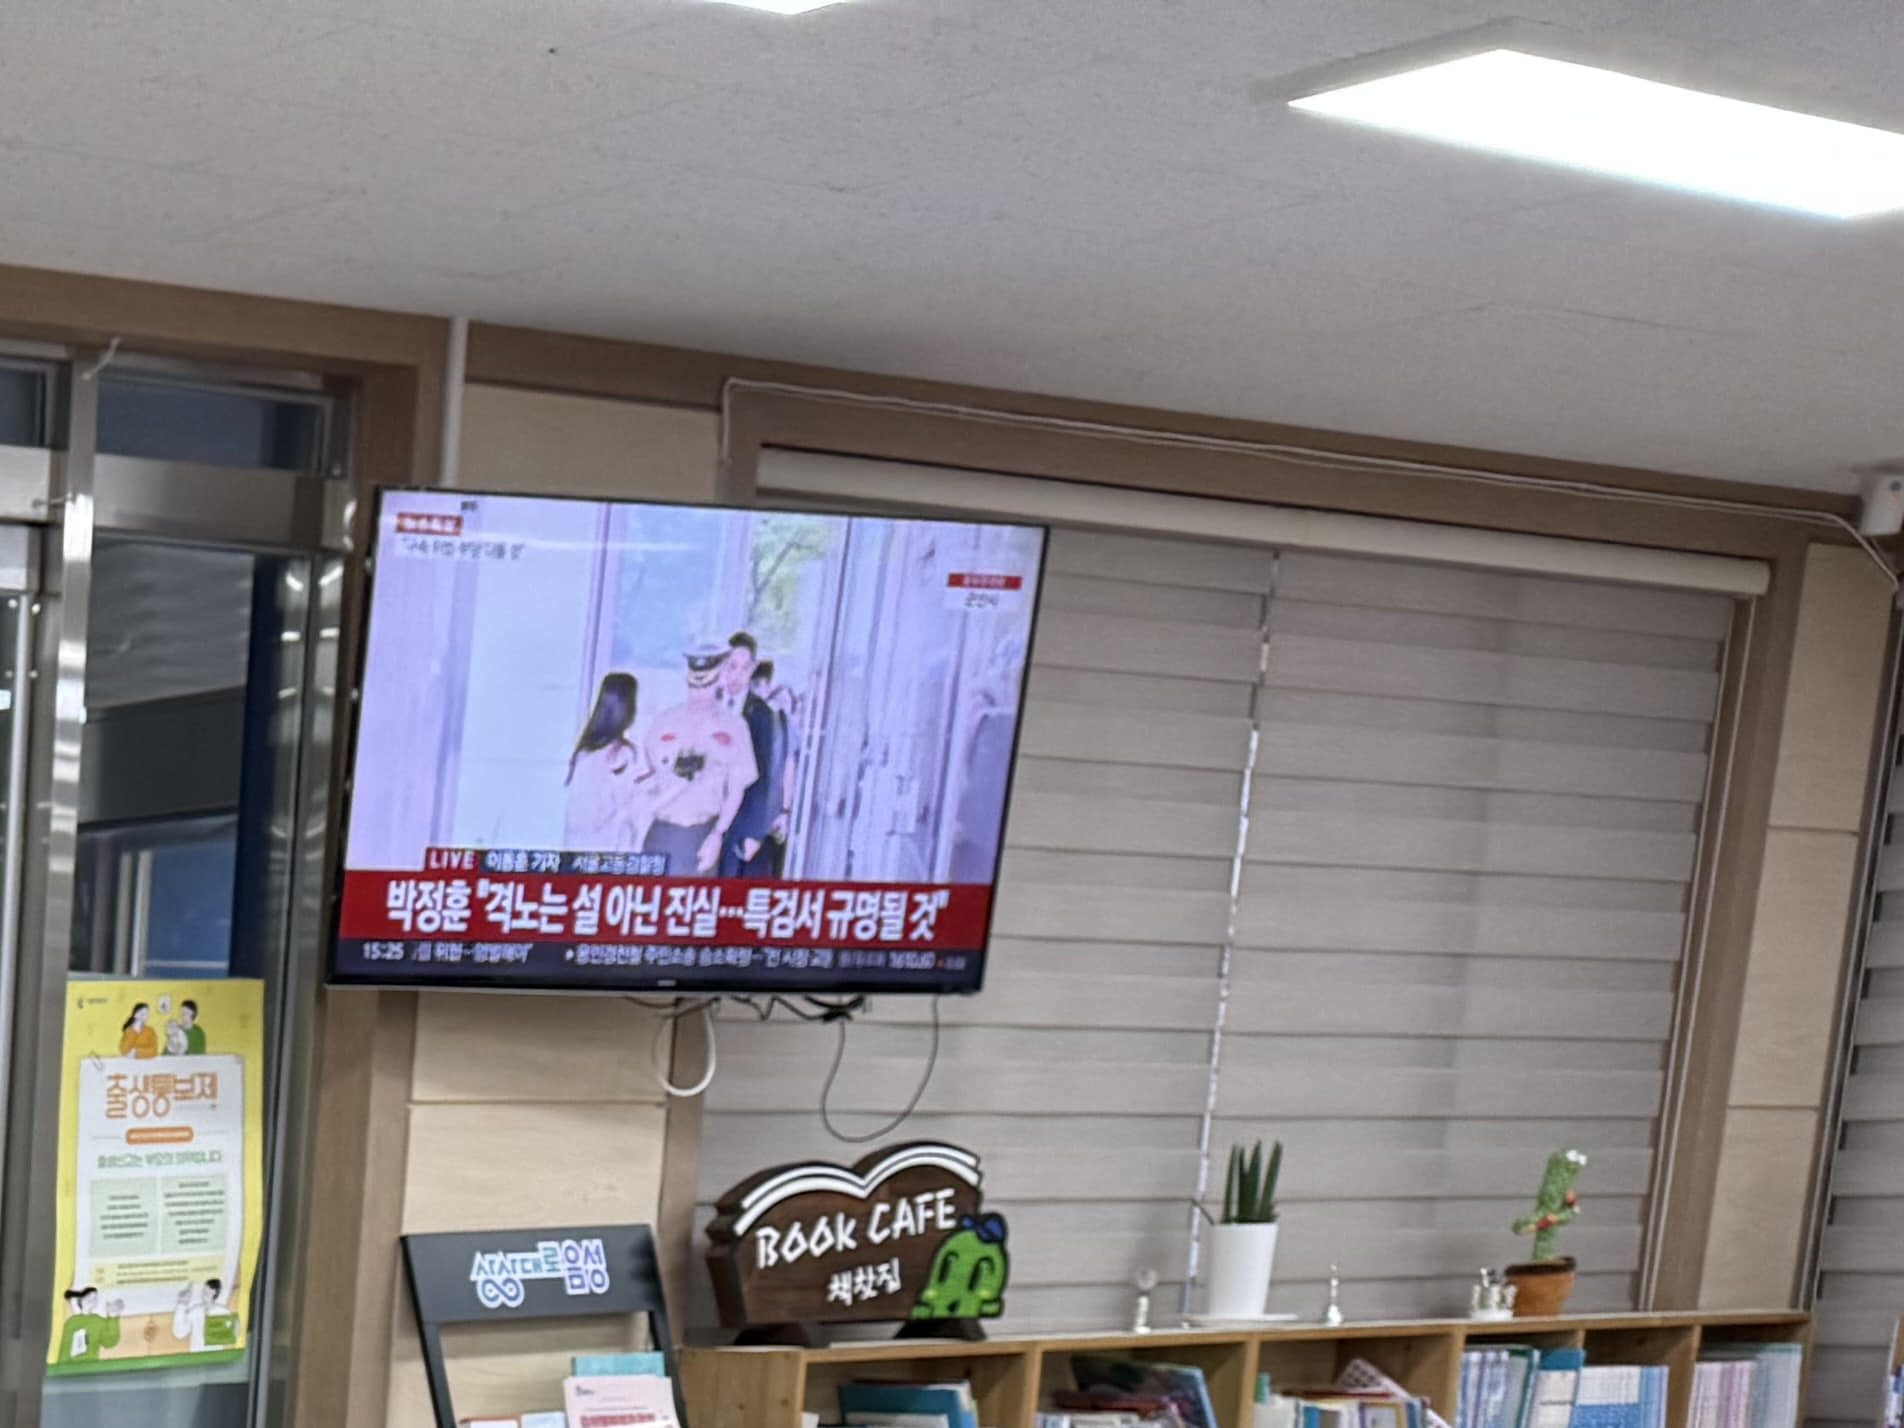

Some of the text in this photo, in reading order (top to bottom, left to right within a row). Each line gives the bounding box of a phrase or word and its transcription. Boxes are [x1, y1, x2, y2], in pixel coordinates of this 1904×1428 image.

[429, 850, 476, 870] LIVE
[530, 852, 561, 874] 기자
[386, 879, 472, 933] 박정훈
[572, 882, 600, 936] 설
[604, 883, 663, 937] 아닌
[826, 889, 909, 941] 규명될
[105, 1072, 219, 1119] 출생통보제
[754, 1187, 957, 1270] BOOK CAFE
